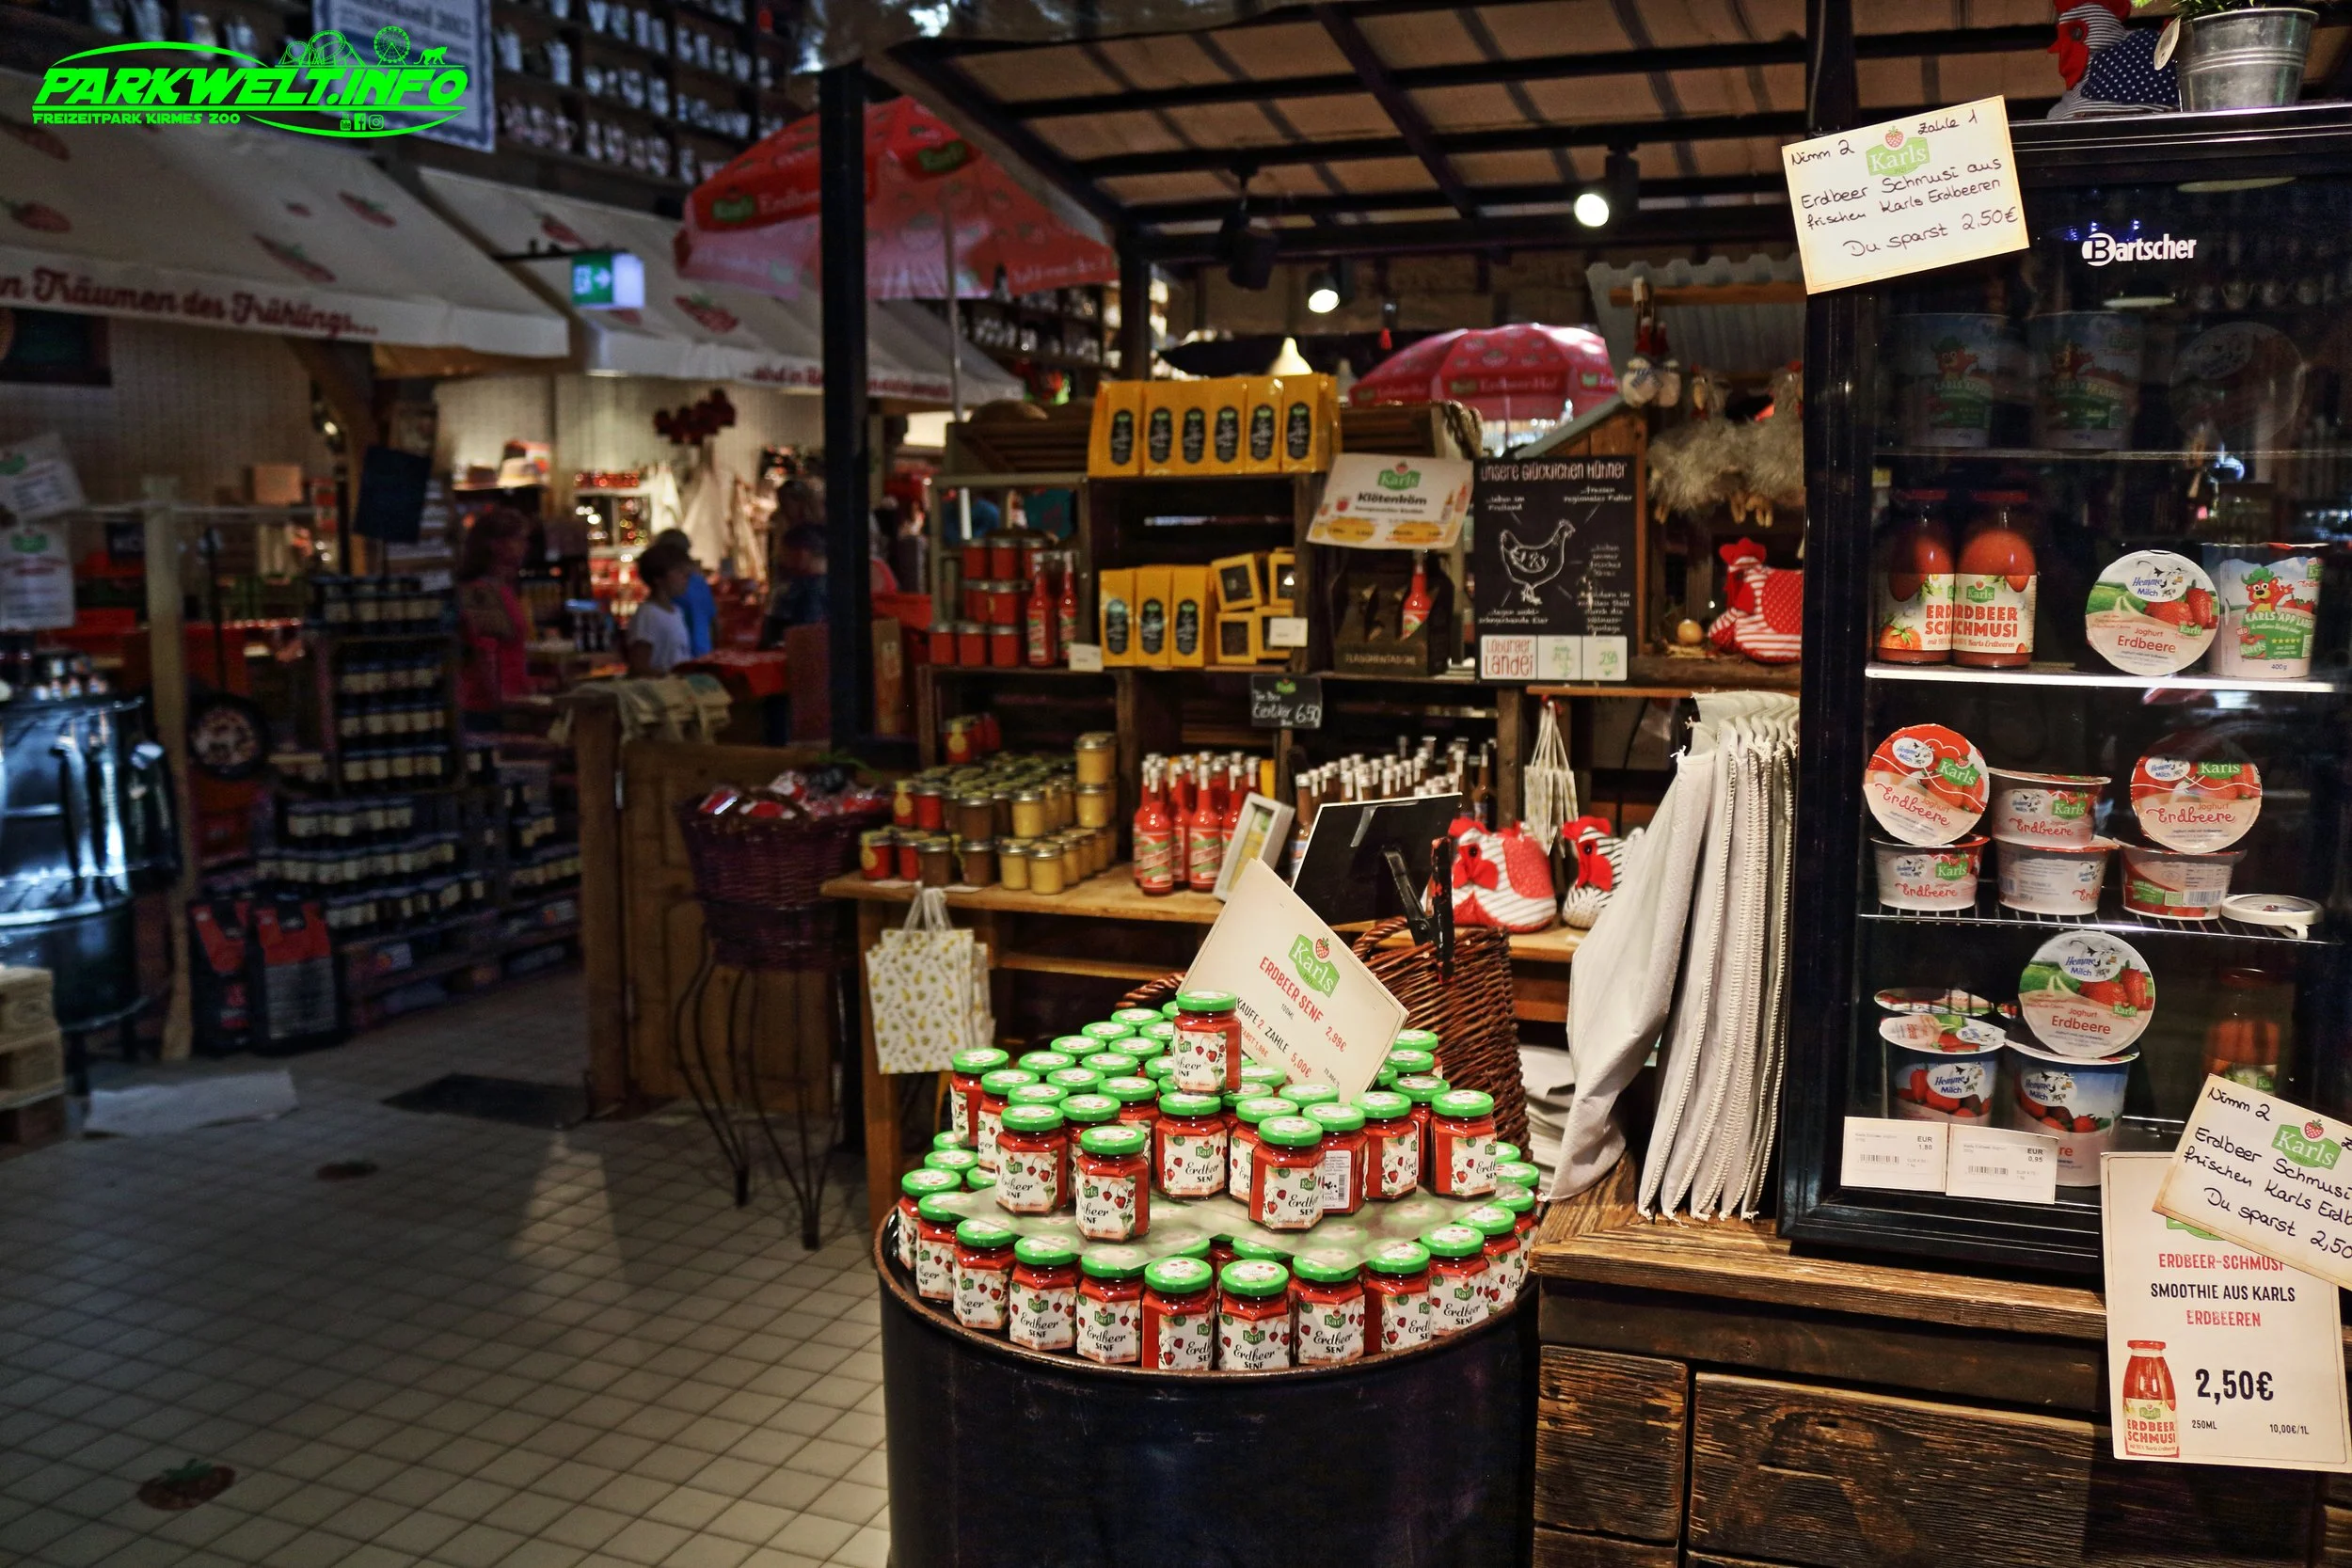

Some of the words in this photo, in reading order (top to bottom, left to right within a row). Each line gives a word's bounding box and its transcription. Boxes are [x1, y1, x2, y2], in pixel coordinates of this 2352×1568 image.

[1791, 149, 1831, 166] Nimm
[1837, 139, 1855, 155] 2
[1917, 119, 1960, 135] Zahle
[1968, 108, 1979, 124] 1
[1869, 145, 1927, 173] Karls
[1802, 187, 1868, 210] Erdbeer
[1882, 166, 1960, 194] Schmusi
[1966, 157, 2002, 174] aus
[1806, 214, 1867, 230] frischen
[1880, 196, 1924, 214] Karls
[1928, 179, 2001, 203] Erdbeeren
[1843, 240, 1881, 257] Du
[1886, 224, 1949, 250] sparst
[2082, 232, 2197, 267] Bartscher
[32, 266, 177, 313] Träumen
[2132, 577, 2163, 587] Hemme
[1967, 586, 1995, 600] Karls
[2137, 588, 2159, 597] Milch
[1954, 605, 2018, 621] RDBEER
[2245, 611, 2276, 623] KARLS
[2279, 612, 2296, 624] APP
[1952, 622, 2018, 638] CHMUSI
[2135, 627, 2163, 637] Joghurt
[2180, 625, 2202, 635] Karls
[2117, 635, 2176, 654] Erdbeere
[1939, 760, 1977, 785] Karls
[2201, 761, 2240, 775] Karls
[1875, 783, 1951, 828] Erdbeere
[2054, 801, 2086, 816] Karls
[2198, 802, 2230, 812] Joghurt
[2146, 806, 2236, 825] Erdbeere
[2009, 818, 2074, 837] Erdbeere
[1937, 863, 1968, 878] Karls
[1895, 882, 1958, 898] Erdbeere
[1292, 941, 1334, 992] Karls
[2064, 956, 2097, 967] Hemme
[2071, 967, 2092, 977] Milch
[1259, 956, 1302, 1003] ERDBEER
[1298, 994, 1325, 1024] SENF
[2069, 1008, 2097, 1018] Joghurt
[2052, 1016, 2111, 1035] Erdbeere
[1236, 997, 1260, 1025] KAUFE
[1257, 1019, 1265, 1031] 2
[1264, 1026, 1290, 1053] ZAHLE
[1290, 1052, 1313, 1079] 5,00€
[1325, 1026, 1347, 1053] 2,99€
[1934, 1074, 1965, 1085] Hemme
[1940, 1085, 1963, 1095] Milch
[2028, 1091, 2049, 1101] Milch
[2207, 1086, 2251, 1113] Nimm
[2255, 1103, 2271, 1121] 2
[2195, 1127, 2262, 1164] Erdbeer
[2276, 1130, 2335, 1167] Karls
[2184, 1146, 2252, 1188] frischen
[2264, 1179, 2312, 1211] Karls
[2203, 1187, 2231, 1212] Du
[2238, 1206, 2296, 1237] sparst
[2151, 1283, 2219, 1300] SMOOTHIE
[2223, 1285, 2249, 1300] AUS
[2252, 1286, 2296, 1302] KARLS
[1444, 1304, 1481, 1318] Erdbeer
[2186, 1309, 2262, 1327] ERDBEEREN
[1021, 1312, 1058, 1329] Erdbeer
[1028, 1329, 1045, 1338] SENF
[1087, 1325, 1126, 1343] Erdbeer
[1243, 1330, 1263, 1343] Karls
[1313, 1331, 1353, 1346] Erdbeer
[1095, 1342, 1113, 1352] SENF
[1233, 1344, 1275, 1361] Erdbeer
[1244, 1361, 1263, 1370] SENF
[2195, 1369, 2274, 1405] 2,50€
[2127, 1418, 2175, 1432] ERDBEER
[2191, 1419, 2217, 1430] 250ML
[2269, 1423, 2310, 1435] 10,00€/1L
[2127, 1431, 2176, 1444] SCHMUSI
